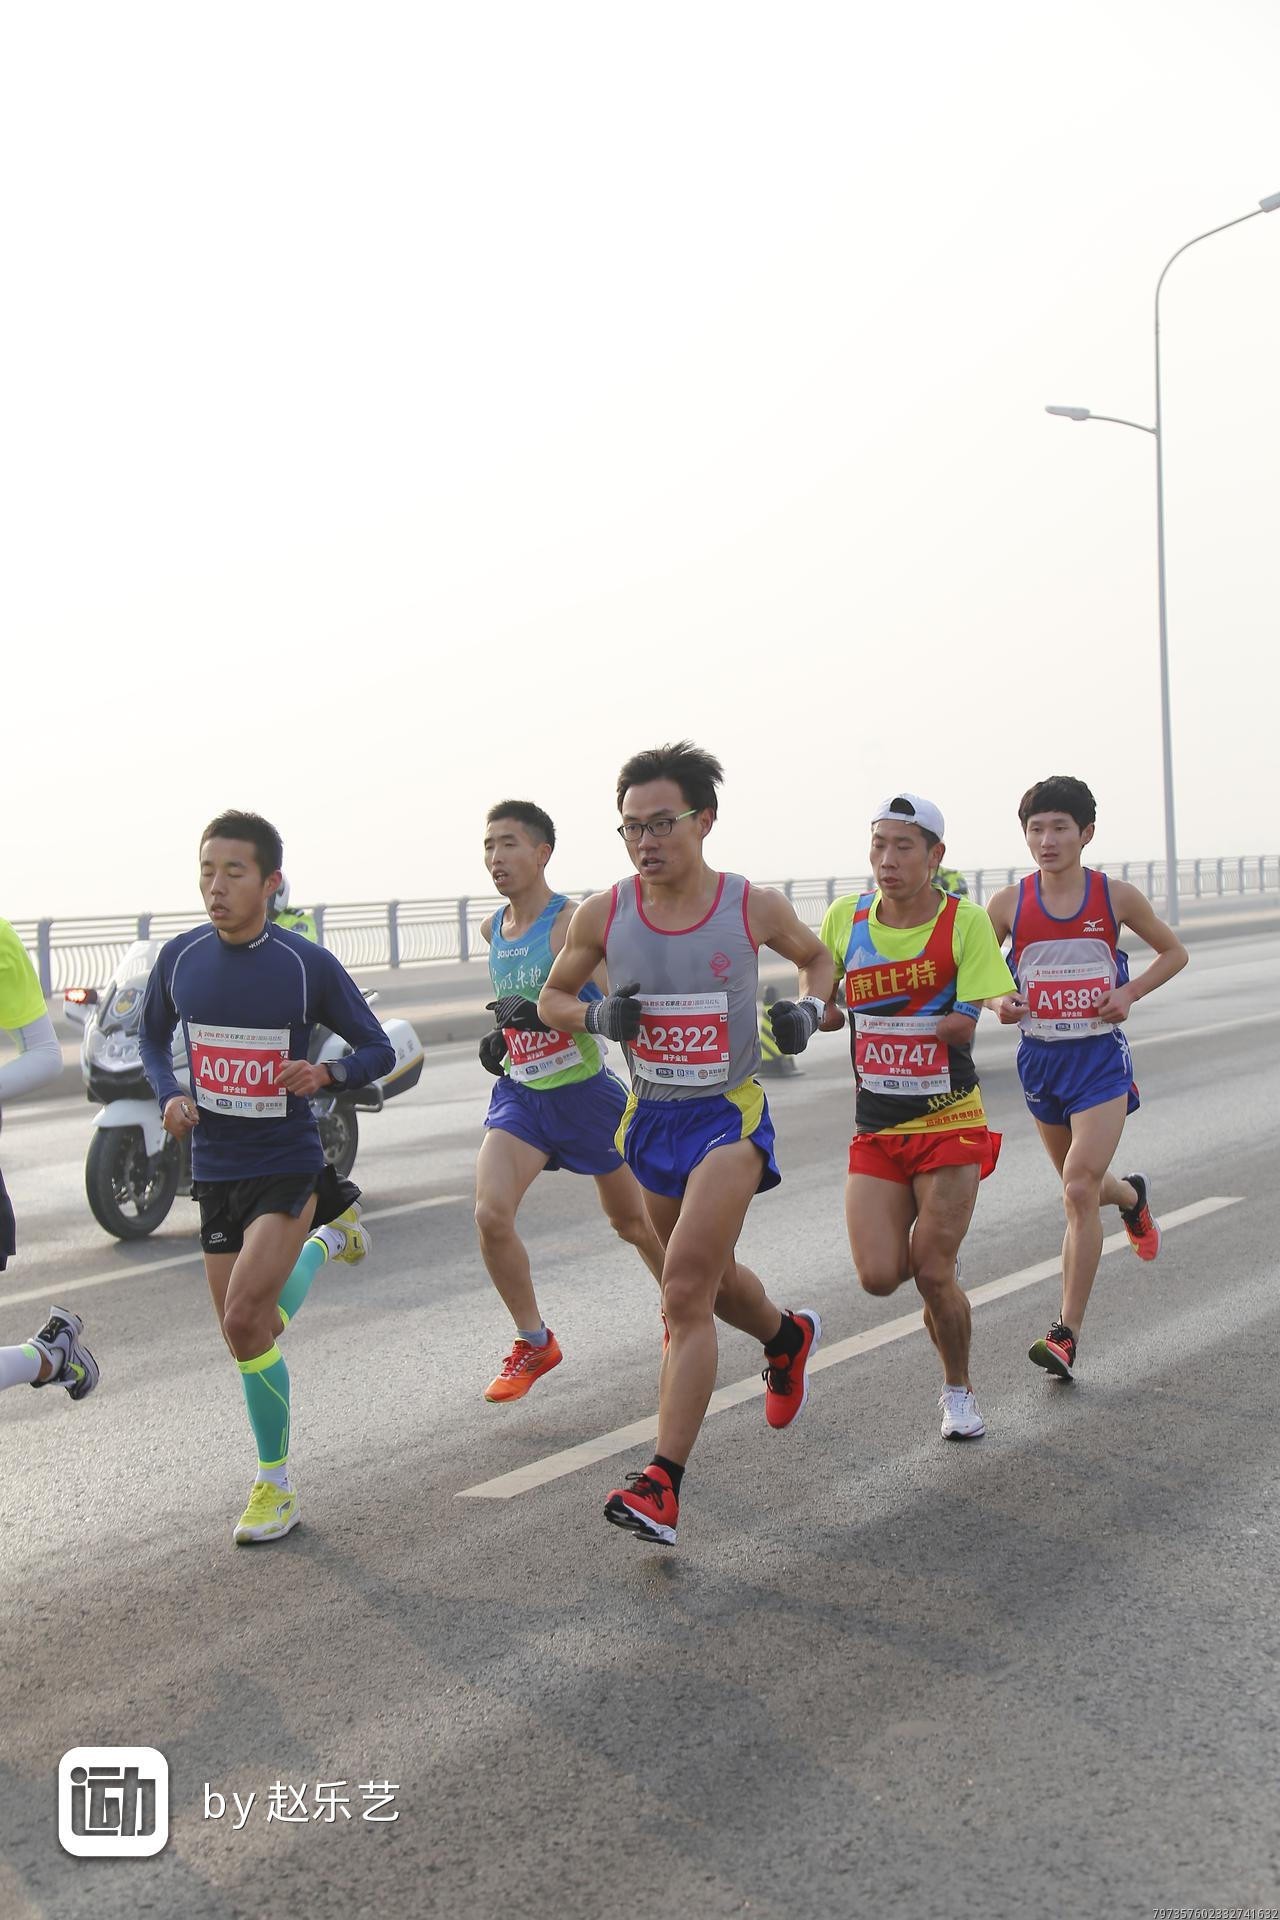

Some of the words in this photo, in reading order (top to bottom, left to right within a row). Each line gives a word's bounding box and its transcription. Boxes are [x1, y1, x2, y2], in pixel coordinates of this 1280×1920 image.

[496, 946, 529, 959] saucony
[849, 959, 937, 1002] 康比特
[636, 1024, 718, 1053] A2322
[864, 1042, 938, 1067] A0747
[199, 1055, 275, 1086] A0701
